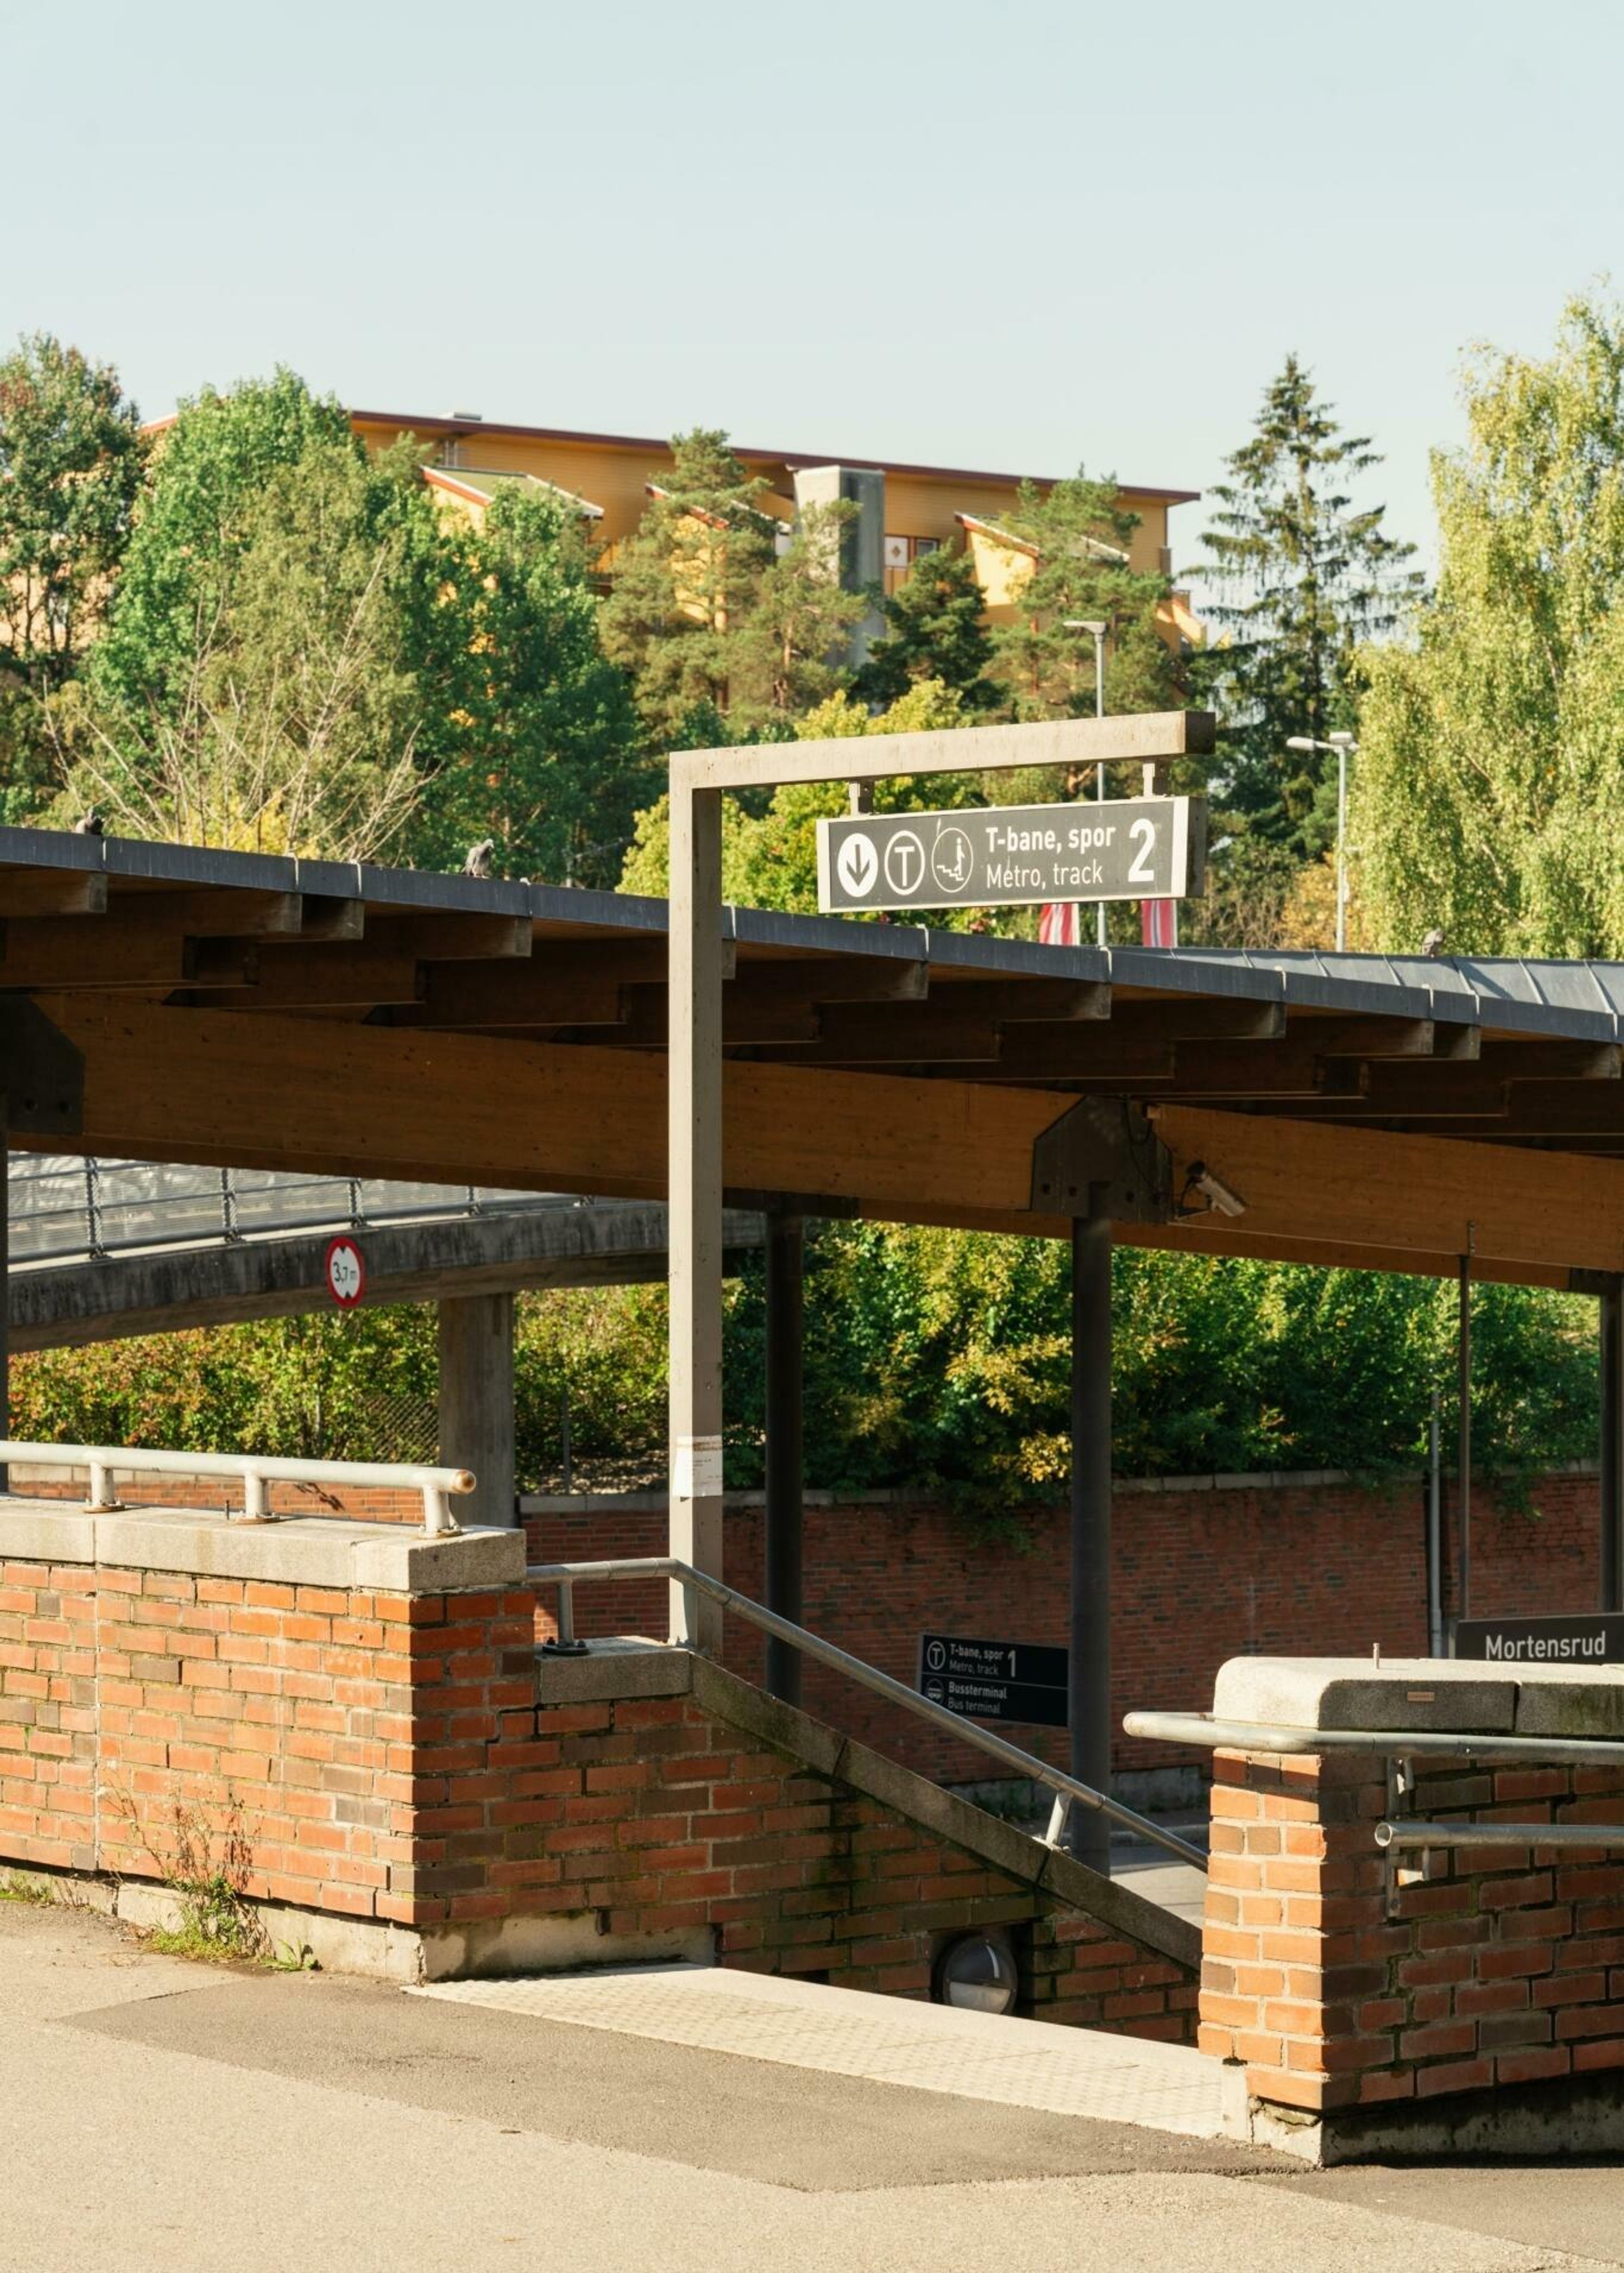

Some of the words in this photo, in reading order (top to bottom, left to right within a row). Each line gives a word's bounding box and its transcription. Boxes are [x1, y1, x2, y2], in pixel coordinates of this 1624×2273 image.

[986, 826, 1062, 854] T-bane,
[1068, 827, 1116, 854] spor
[1128, 818, 1156, 882] 2
[894, 847, 915, 886] T
[987, 864, 1046, 890] Metro,
[1053, 858, 1103, 885] track
[333, 1261, 348, 1283] 3,7
[350, 1270, 357, 1280] m
[932, 1648, 941, 1666] T
[949, 1643, 982, 1659] T-bane,
[984, 1651, 1004, 1661] spor
[1486, 1630, 1606, 1660] Mortensrud
[949, 1659, 975, 1673] Metro,
[977, 1664, 999, 1675] track
[1007, 1650, 1016, 1677] 1
[949, 1681, 1007, 1699] Bussterminal
[948, 1697, 963, 1710] Bus
[966, 1699, 1001, 1714] terminal
